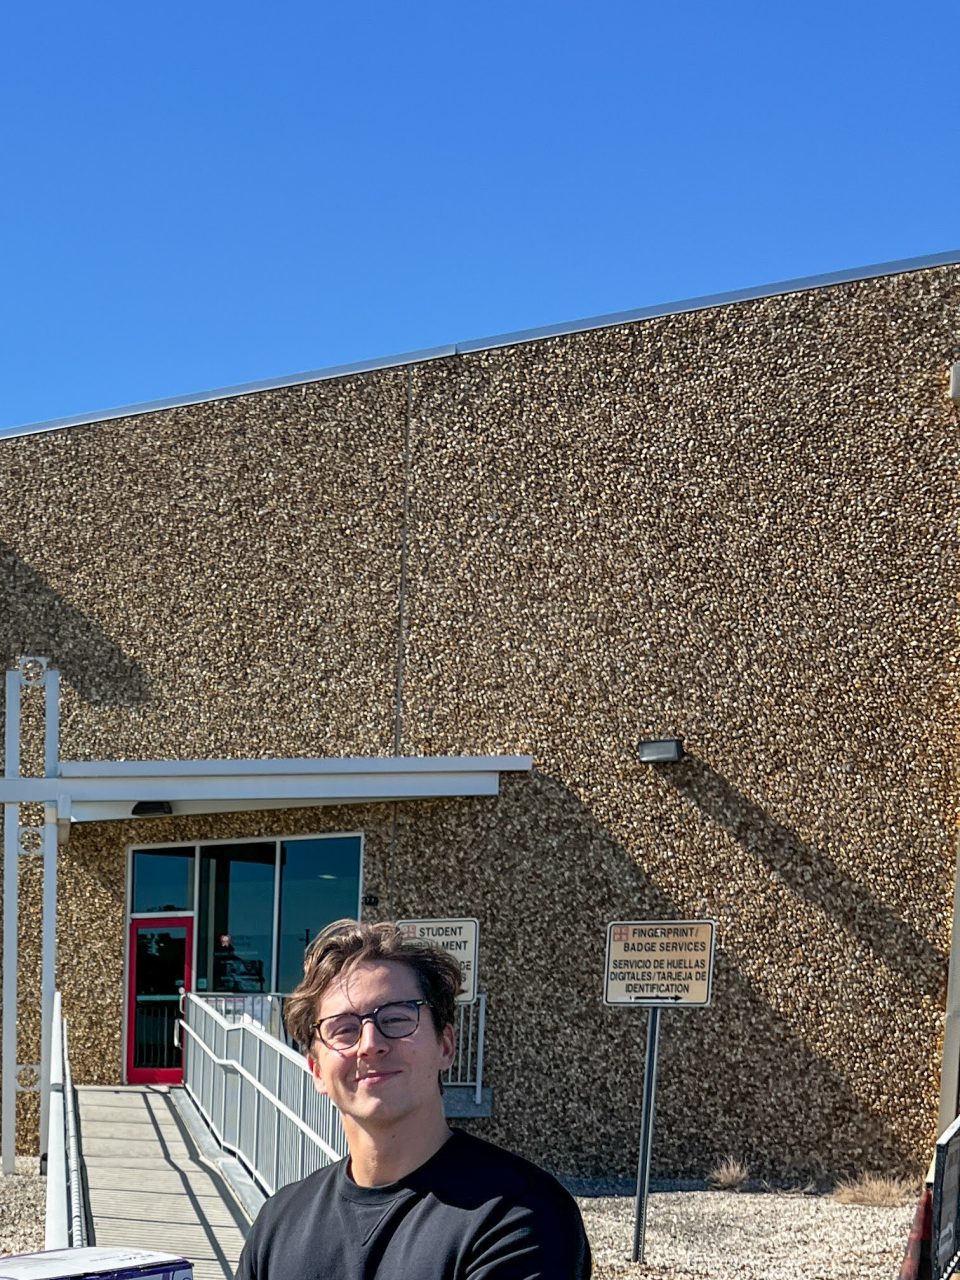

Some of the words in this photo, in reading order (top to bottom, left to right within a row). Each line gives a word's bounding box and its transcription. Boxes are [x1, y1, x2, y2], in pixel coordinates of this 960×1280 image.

[419, 926, 463, 937] STUDENT
[632, 927, 699, 938] FINGERPRINT/
[623, 942, 657, 952] BADGE
[659, 941, 706, 952] SERVICES
[612, 959, 651, 969] SERVICIO
[653, 959, 665, 969] DE
[667, 959, 705, 969] HUELLAS
[695, 971, 706, 981] DE
[625, 983, 689, 993] IDENTIFICATION
